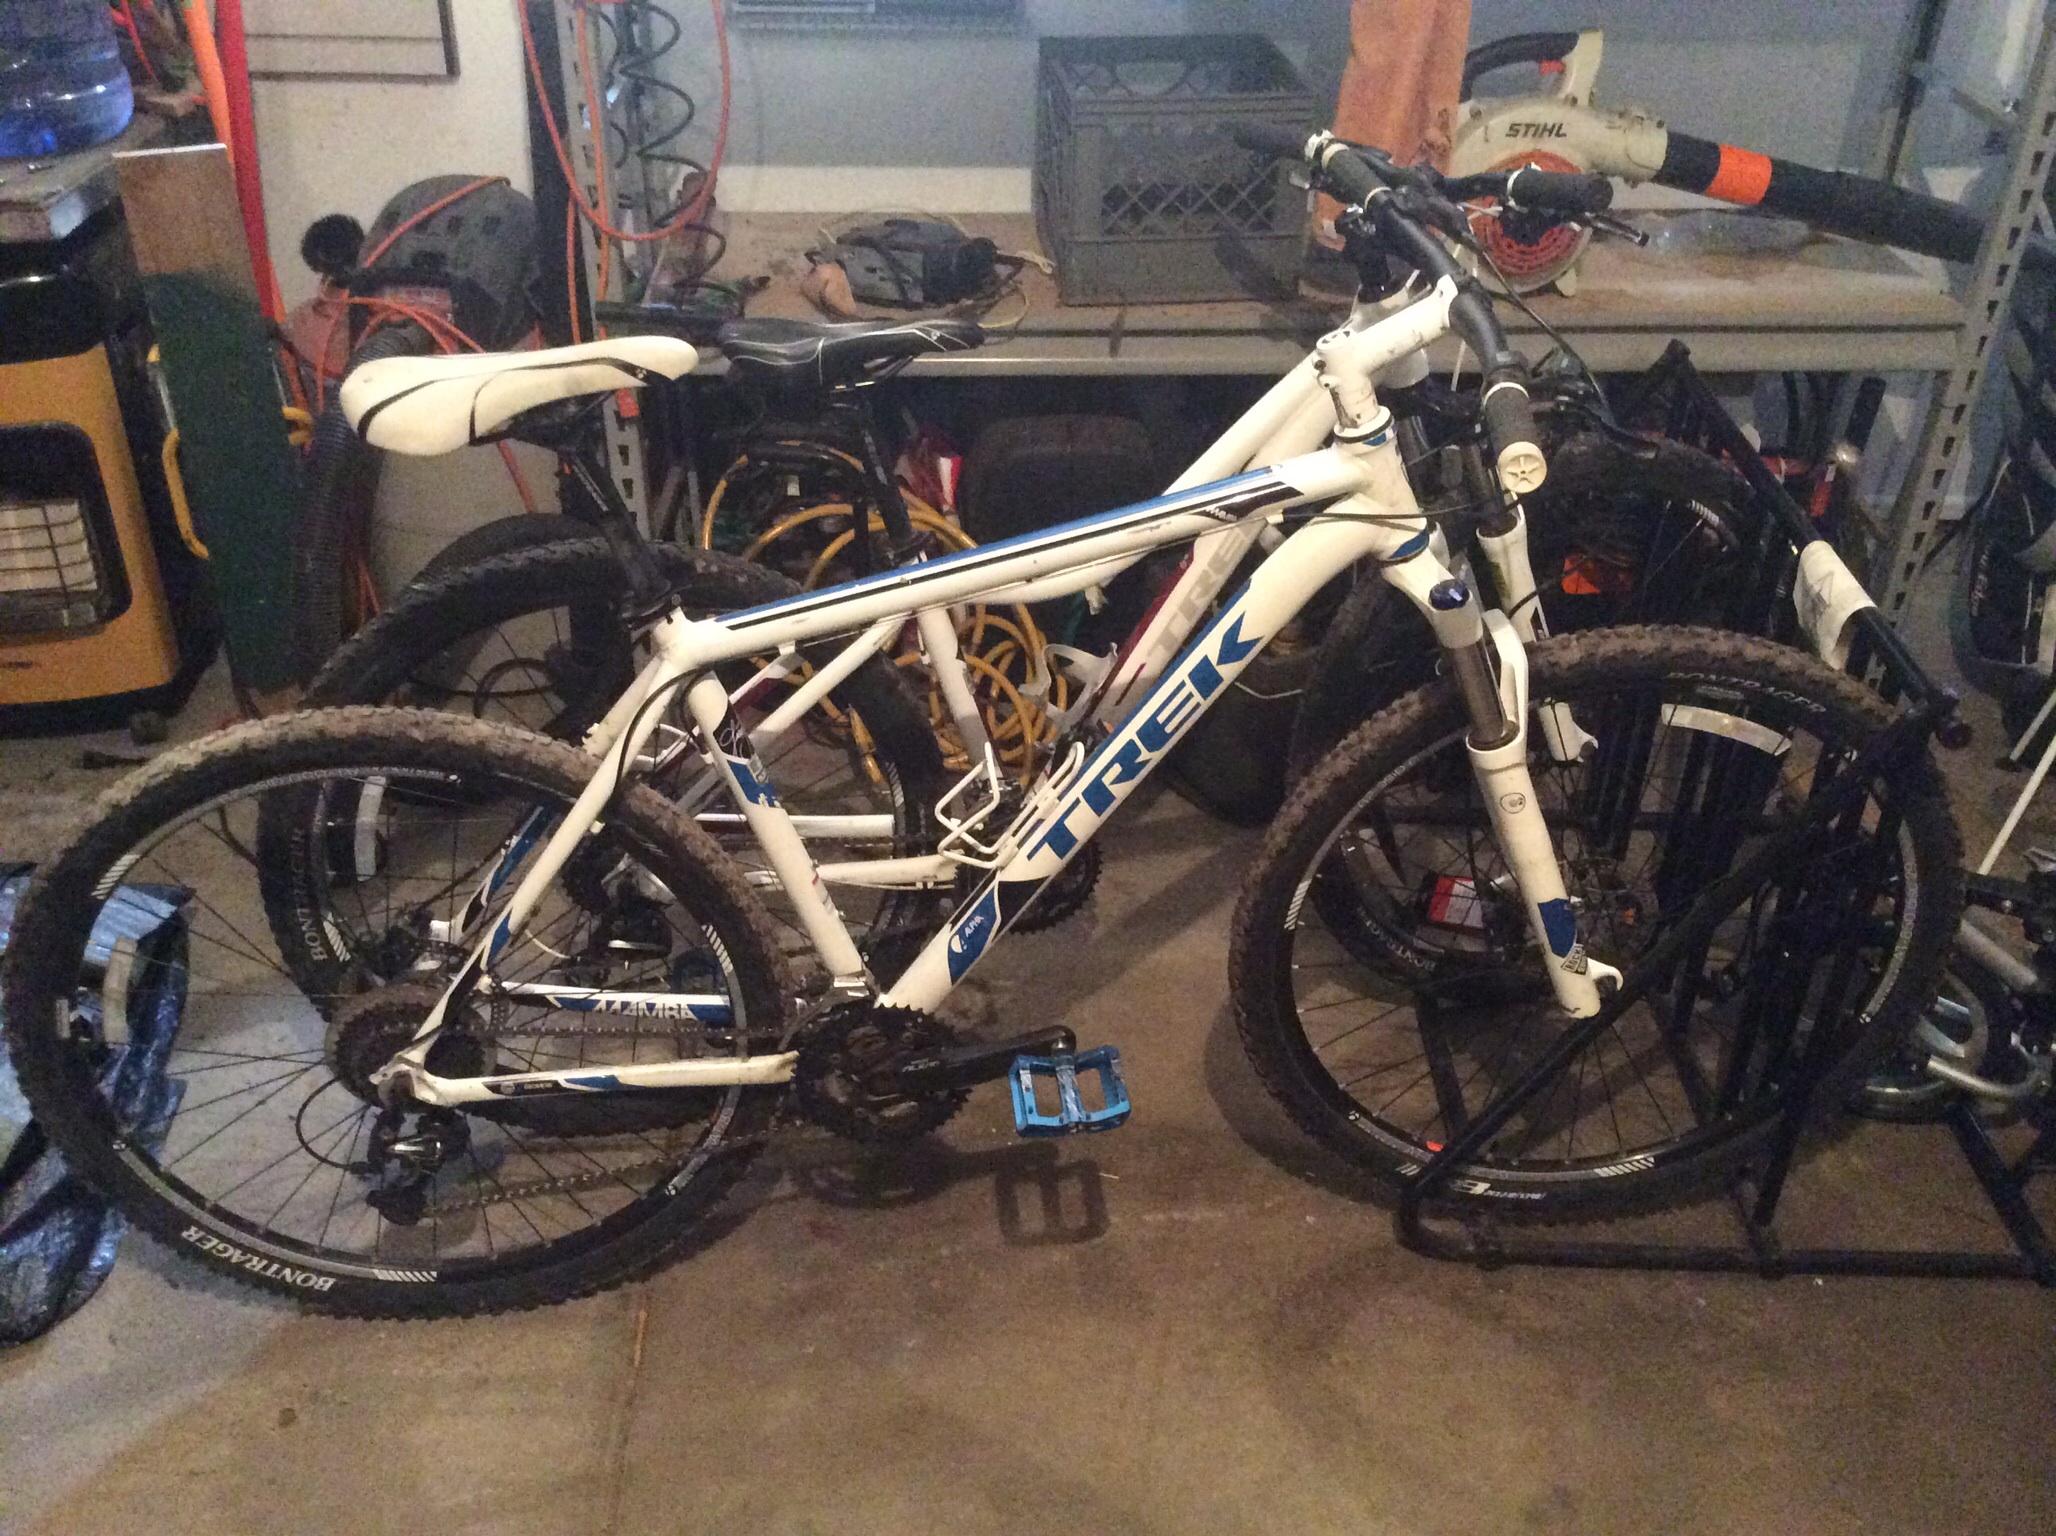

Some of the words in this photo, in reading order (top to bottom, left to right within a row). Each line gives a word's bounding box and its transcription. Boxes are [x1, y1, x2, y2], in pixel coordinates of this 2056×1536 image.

[1505, 122, 1567, 138] STIHL
[1027, 611, 1265, 861] TREK
[181, 1225, 336, 1292] BONTRAGER
